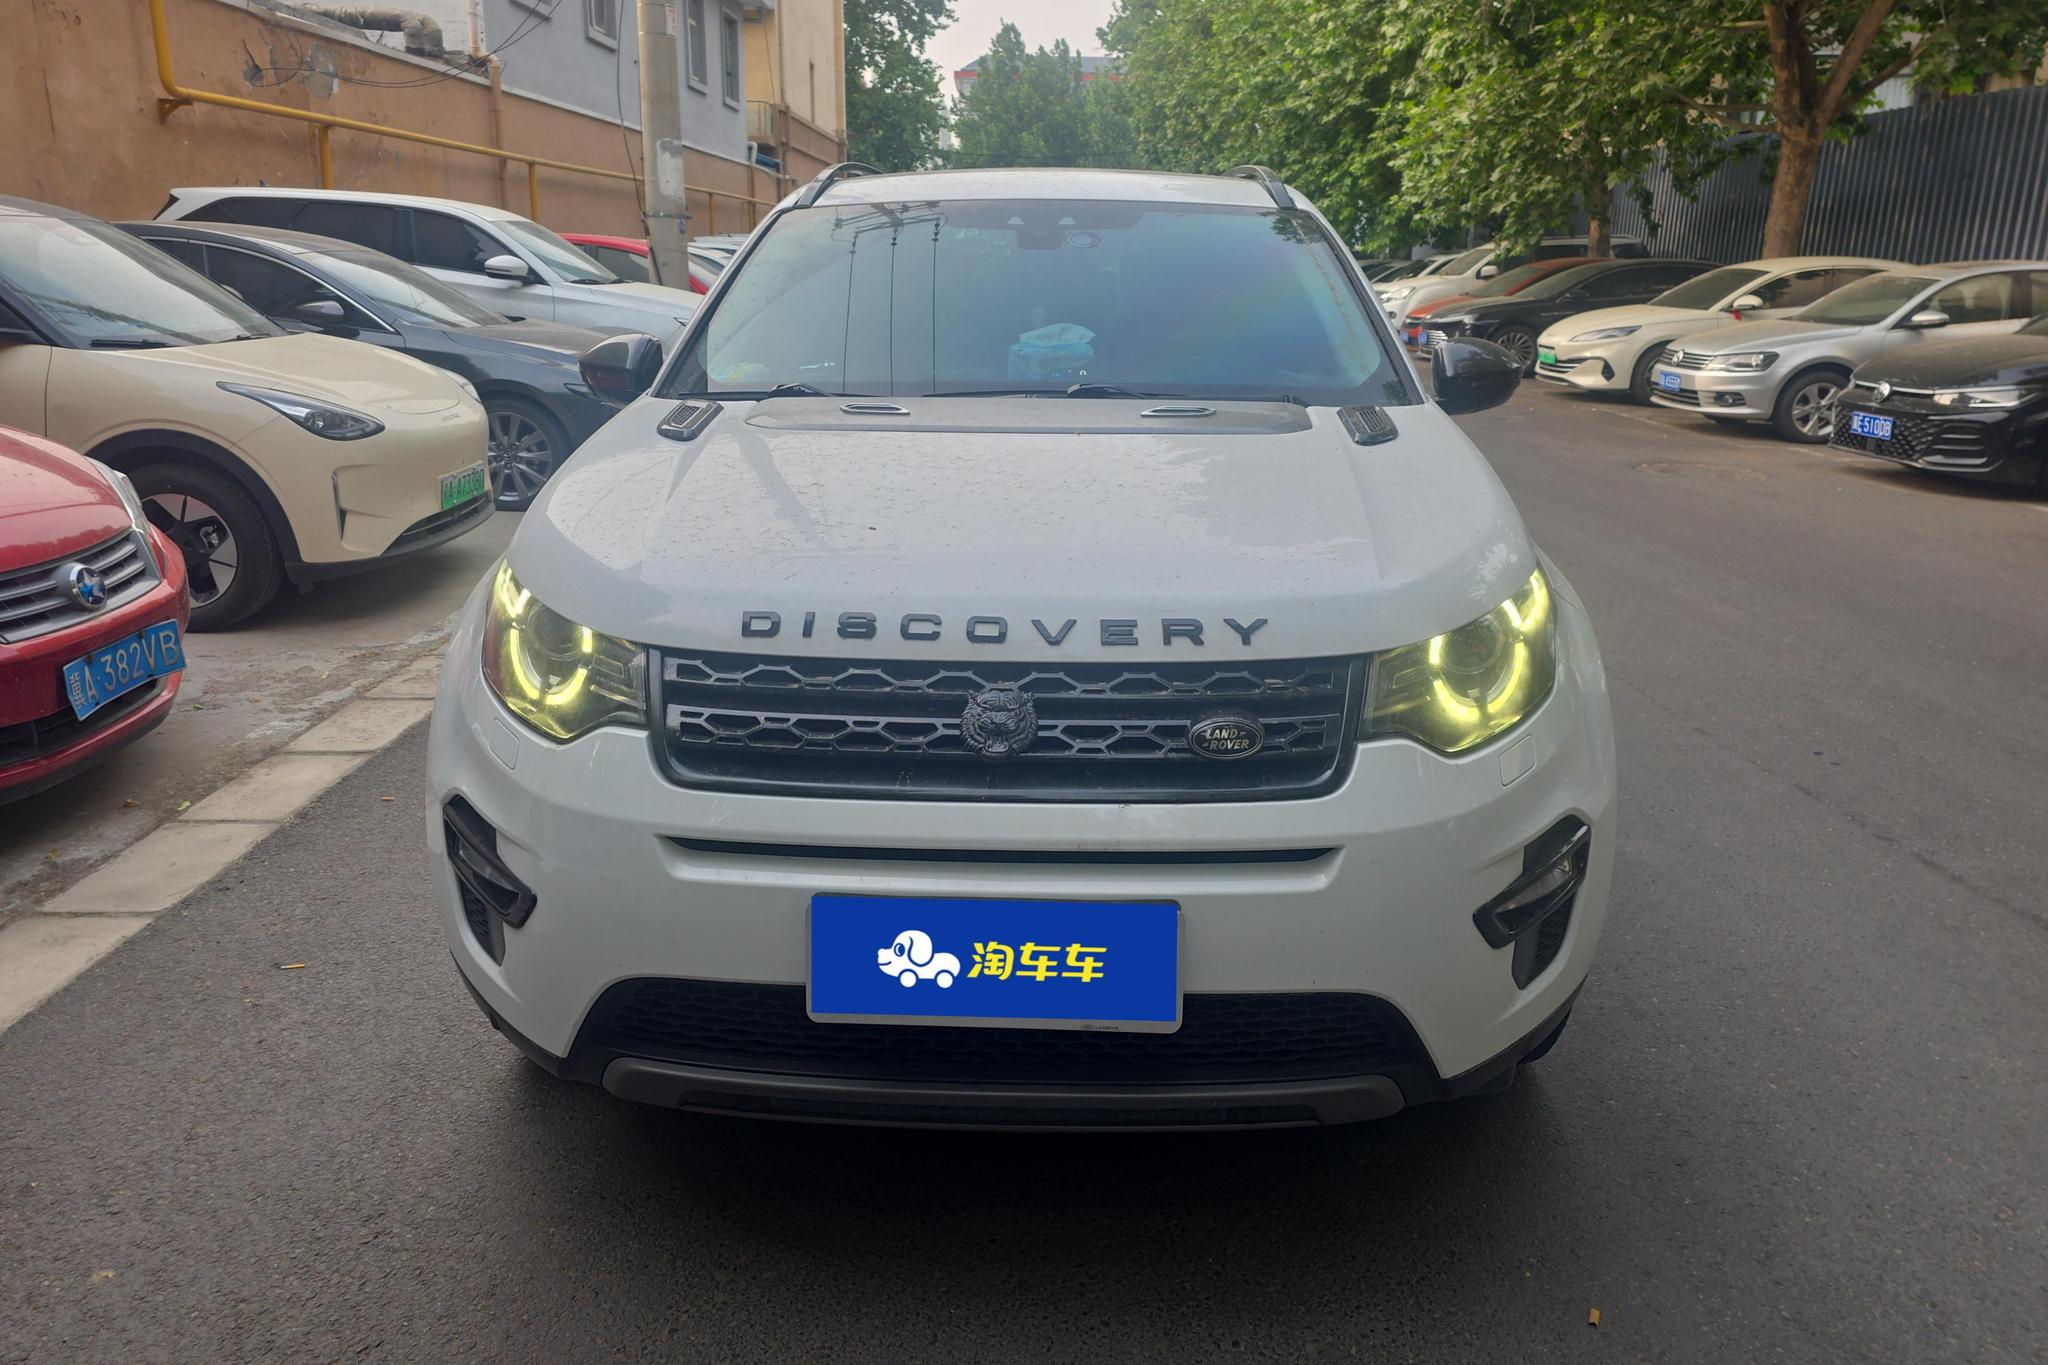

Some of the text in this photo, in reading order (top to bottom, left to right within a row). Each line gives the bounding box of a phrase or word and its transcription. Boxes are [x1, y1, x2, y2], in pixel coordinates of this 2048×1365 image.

[741, 610, 1268, 646] DISCOVERY
[1206, 728, 1238, 739] LAND
[1209, 739, 1249, 750] ROVER
